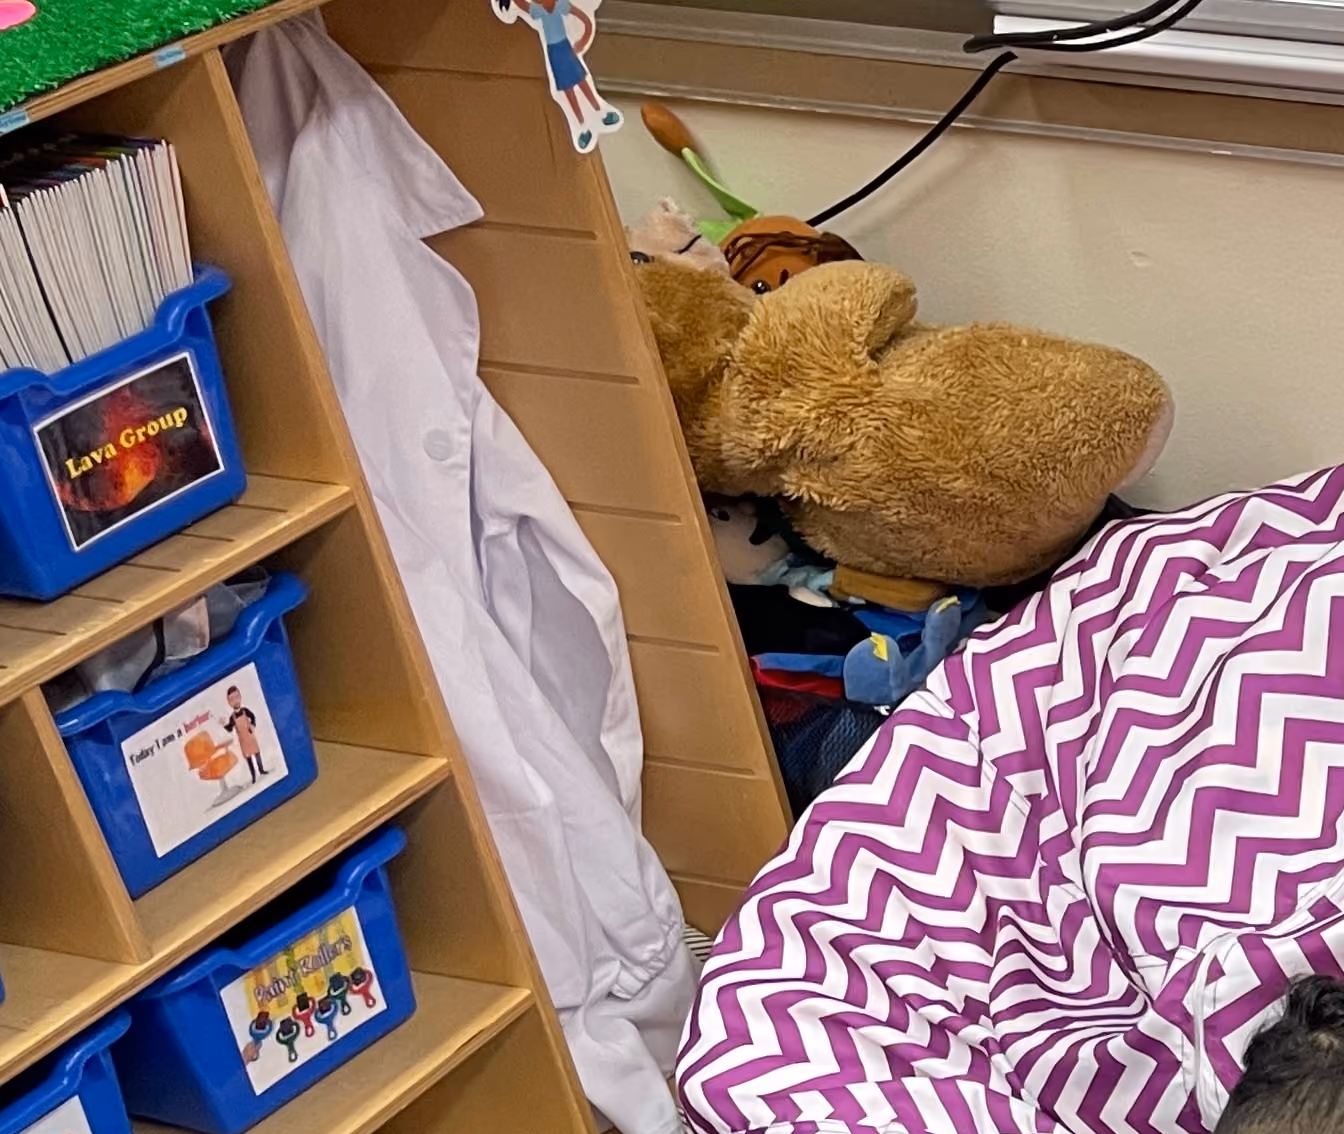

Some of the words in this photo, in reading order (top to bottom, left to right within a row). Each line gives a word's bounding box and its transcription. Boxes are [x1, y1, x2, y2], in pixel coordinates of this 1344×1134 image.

[65, 442, 118, 480] Lava
[119, 406, 188, 449] Group
[129, 744, 156, 767] Today
[162, 733, 176, 748] am
[298, 933, 353, 978] Rollers
